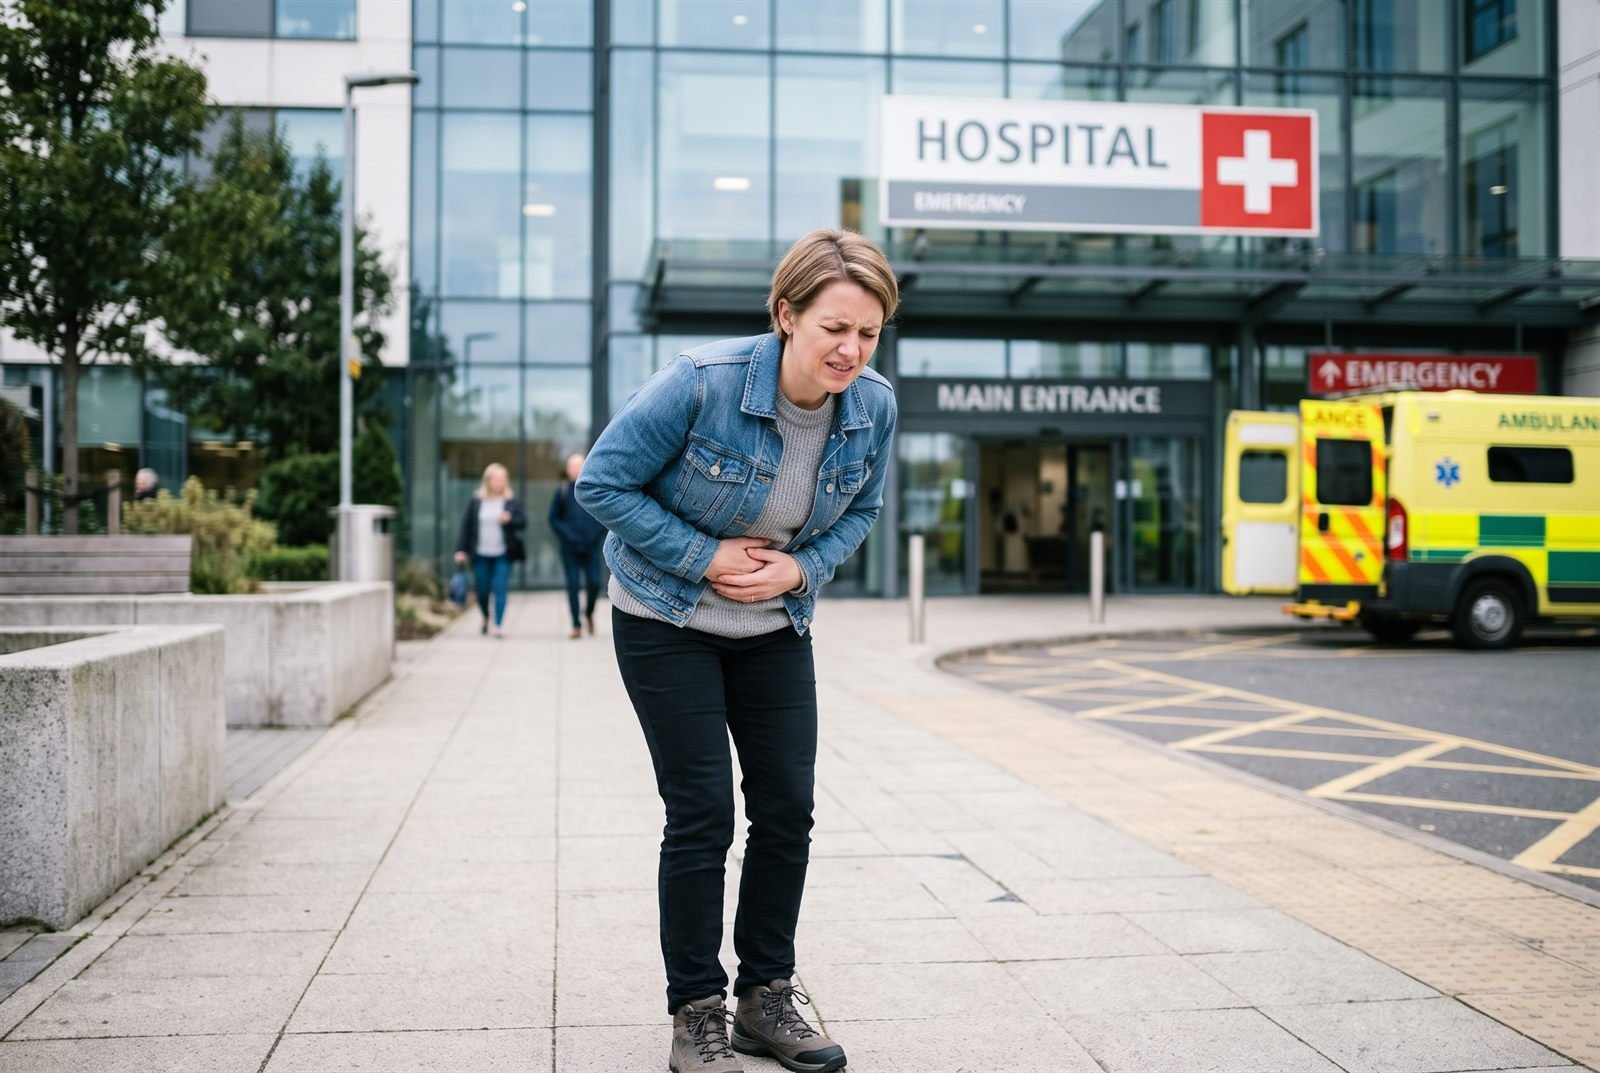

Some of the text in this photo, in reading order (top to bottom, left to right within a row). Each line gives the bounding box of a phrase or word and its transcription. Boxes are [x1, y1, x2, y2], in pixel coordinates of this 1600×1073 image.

[917, 118, 1169, 169] HOSPITAL
[914, 191, 1026, 215] EMERGENCY
[1346, 361, 1503, 389] EMERGENCY
[937, 384, 1162, 414] MAIN ENTRANCE
